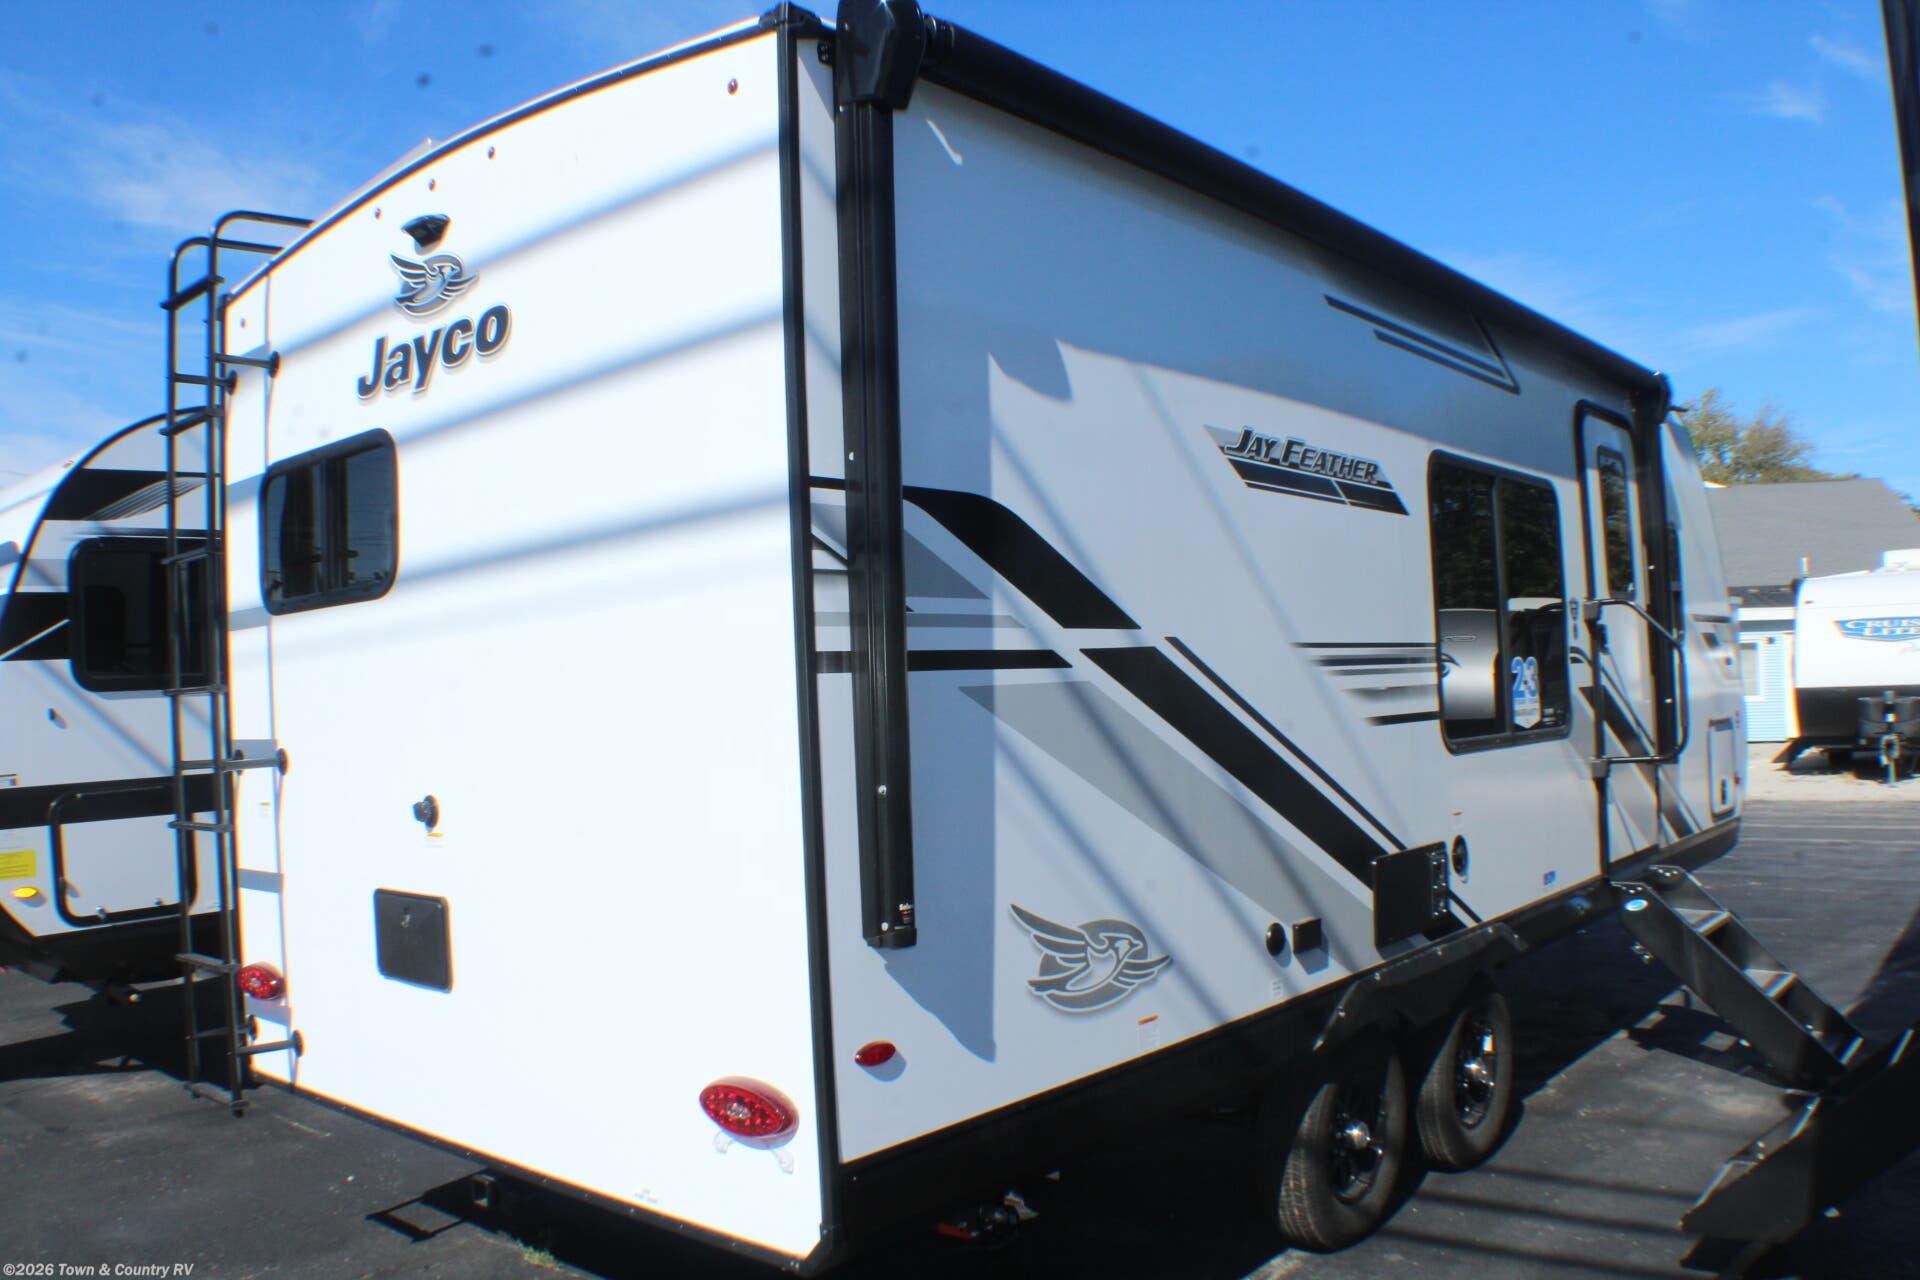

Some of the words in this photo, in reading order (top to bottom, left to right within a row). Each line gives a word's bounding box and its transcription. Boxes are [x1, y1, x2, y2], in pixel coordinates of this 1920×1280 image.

[357, 304, 511, 398] Jayco
[1225, 427, 1277, 461] JAY
[1280, 436, 1380, 483] FEATHER
